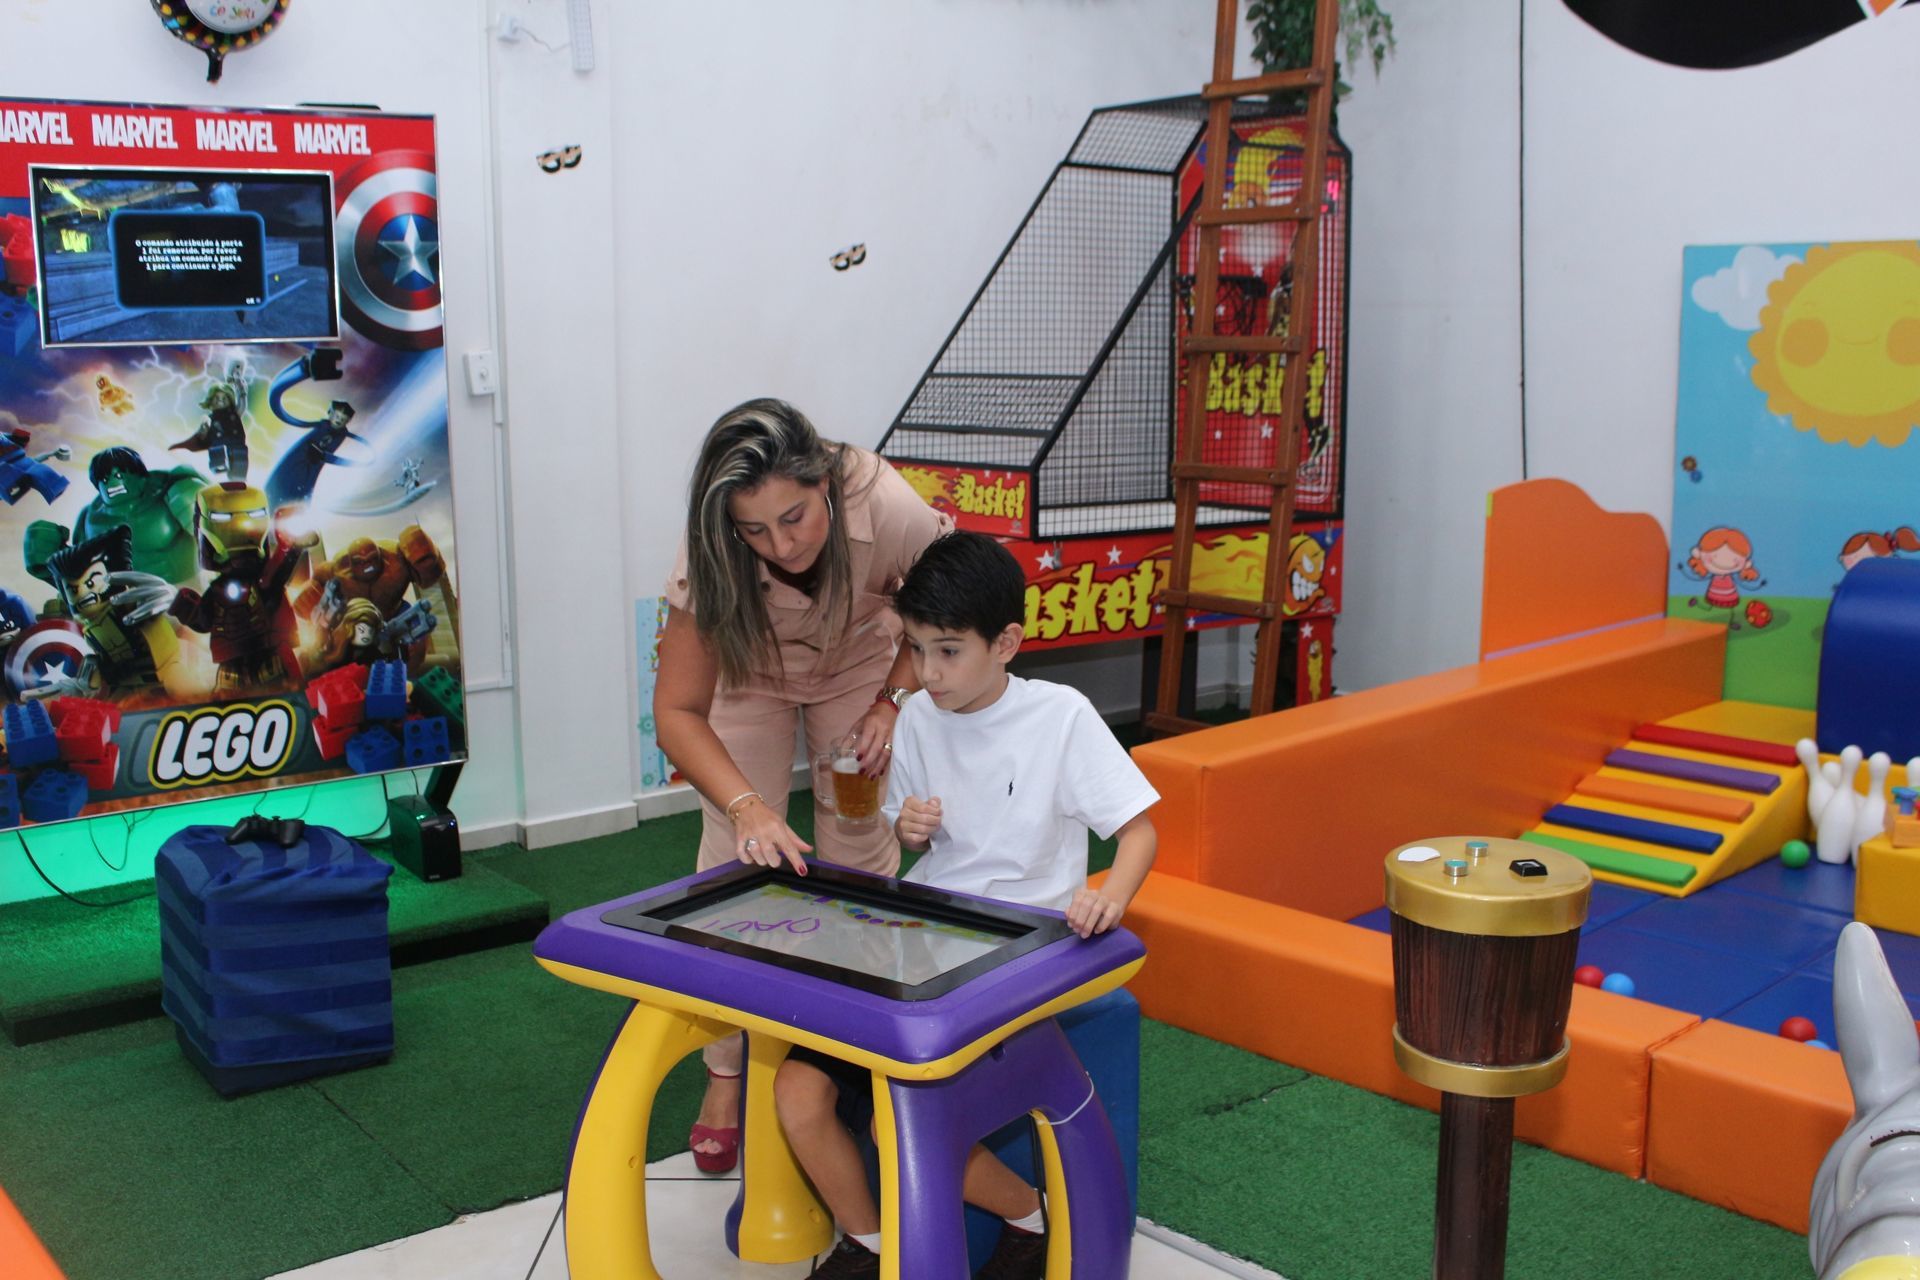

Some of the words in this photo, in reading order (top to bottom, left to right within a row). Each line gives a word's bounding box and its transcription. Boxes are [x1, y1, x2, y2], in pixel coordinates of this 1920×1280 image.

[91, 113, 178, 149] MARVEL
[195, 118, 277, 152] MARVEL
[293, 122, 371, 155] MARVEL
[139, 255, 169, 263] atribua
[171, 255, 181, 263] um
[181, 255, 213, 263] comando
[220, 255, 243, 264] porta
[142, 239, 175, 248] comando
[220, 240, 243, 249] porta
[148, 247, 161, 255] foi
[216, 247, 238, 255] favor
[152, 263, 171, 272] para
[171, 263, 211, 271] continuar
[1204, 350, 1327, 418] Baskt
[953, 473, 1026, 520] Basket
[1024, 559, 1156, 640] asket
[156, 707, 291, 781] LEGO
